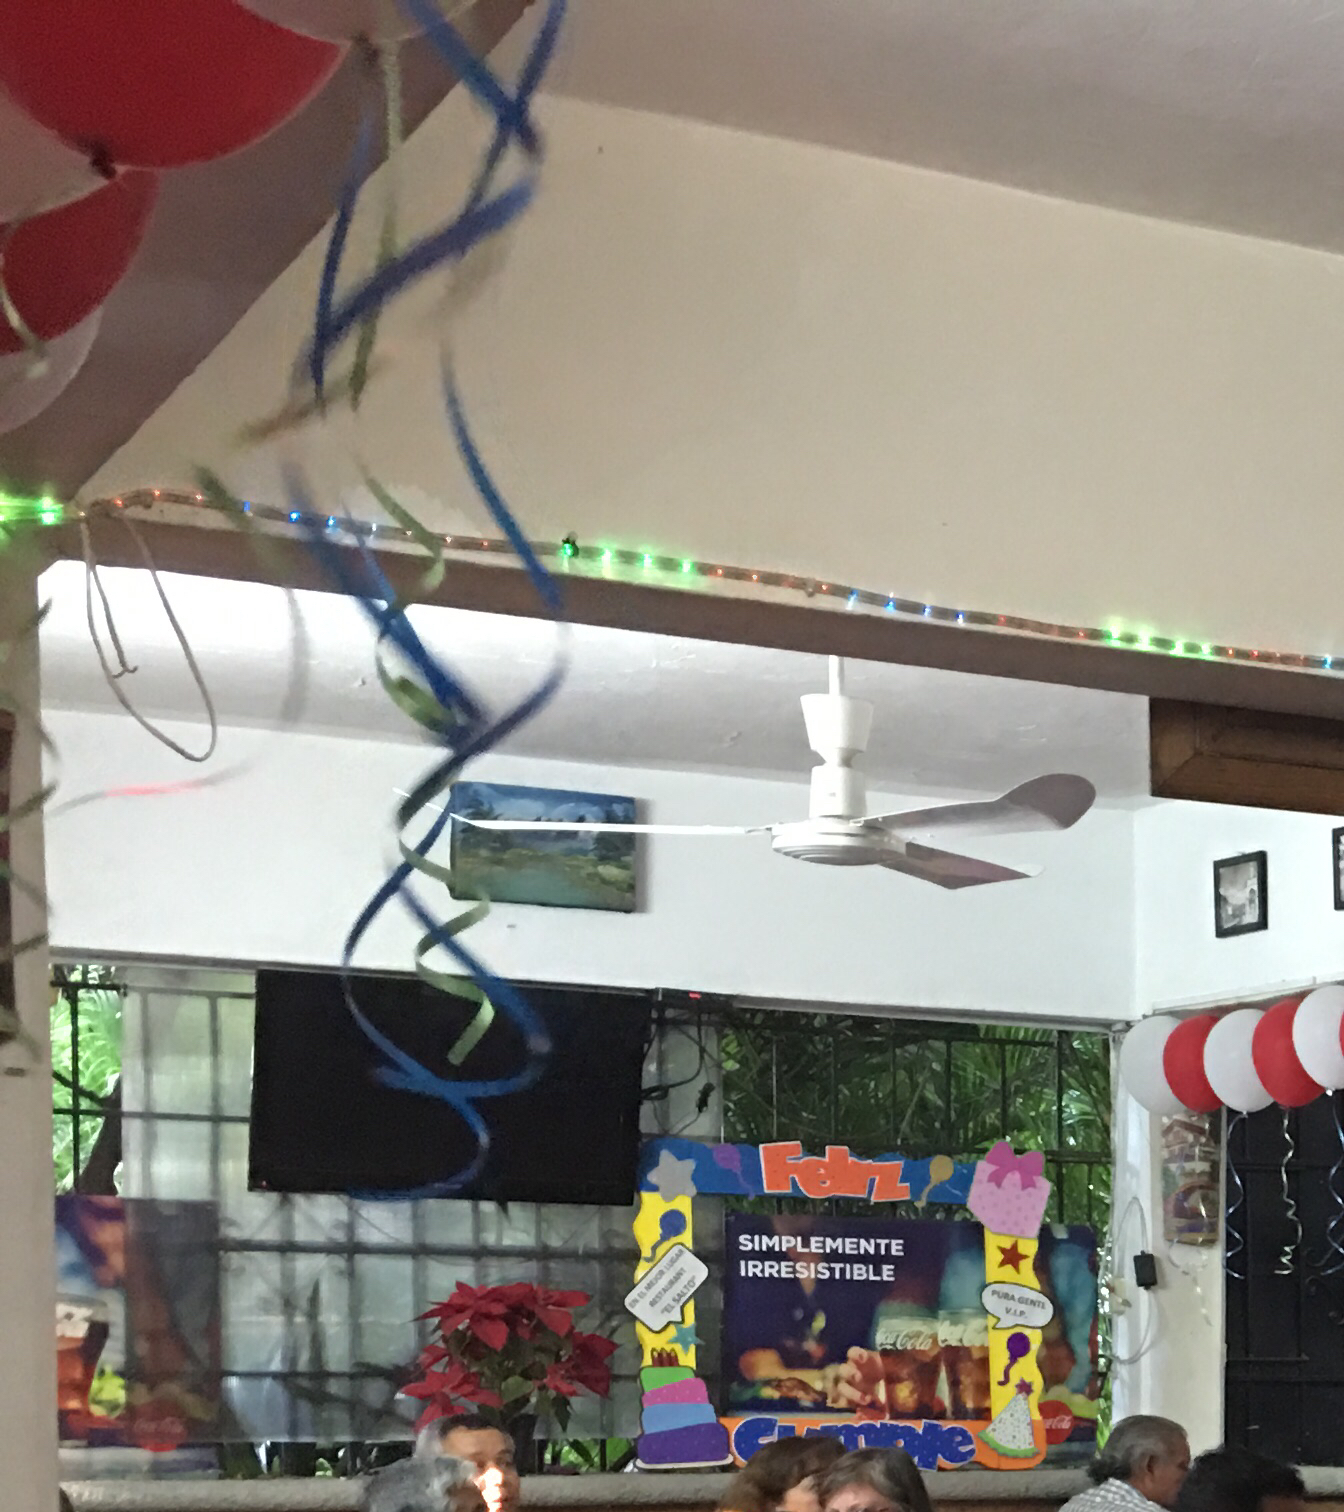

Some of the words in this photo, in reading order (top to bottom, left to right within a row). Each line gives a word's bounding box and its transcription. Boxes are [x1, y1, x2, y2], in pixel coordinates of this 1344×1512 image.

[759, 1141, 911, 1204] Feliz
[738, 1234, 905, 1256] SIMPLEMENTE
[739, 1260, 896, 1281] IRRESISTIBLE
[991, 1289, 1016, 1302] PURA
[1017, 1296, 1047, 1310] GENTE
